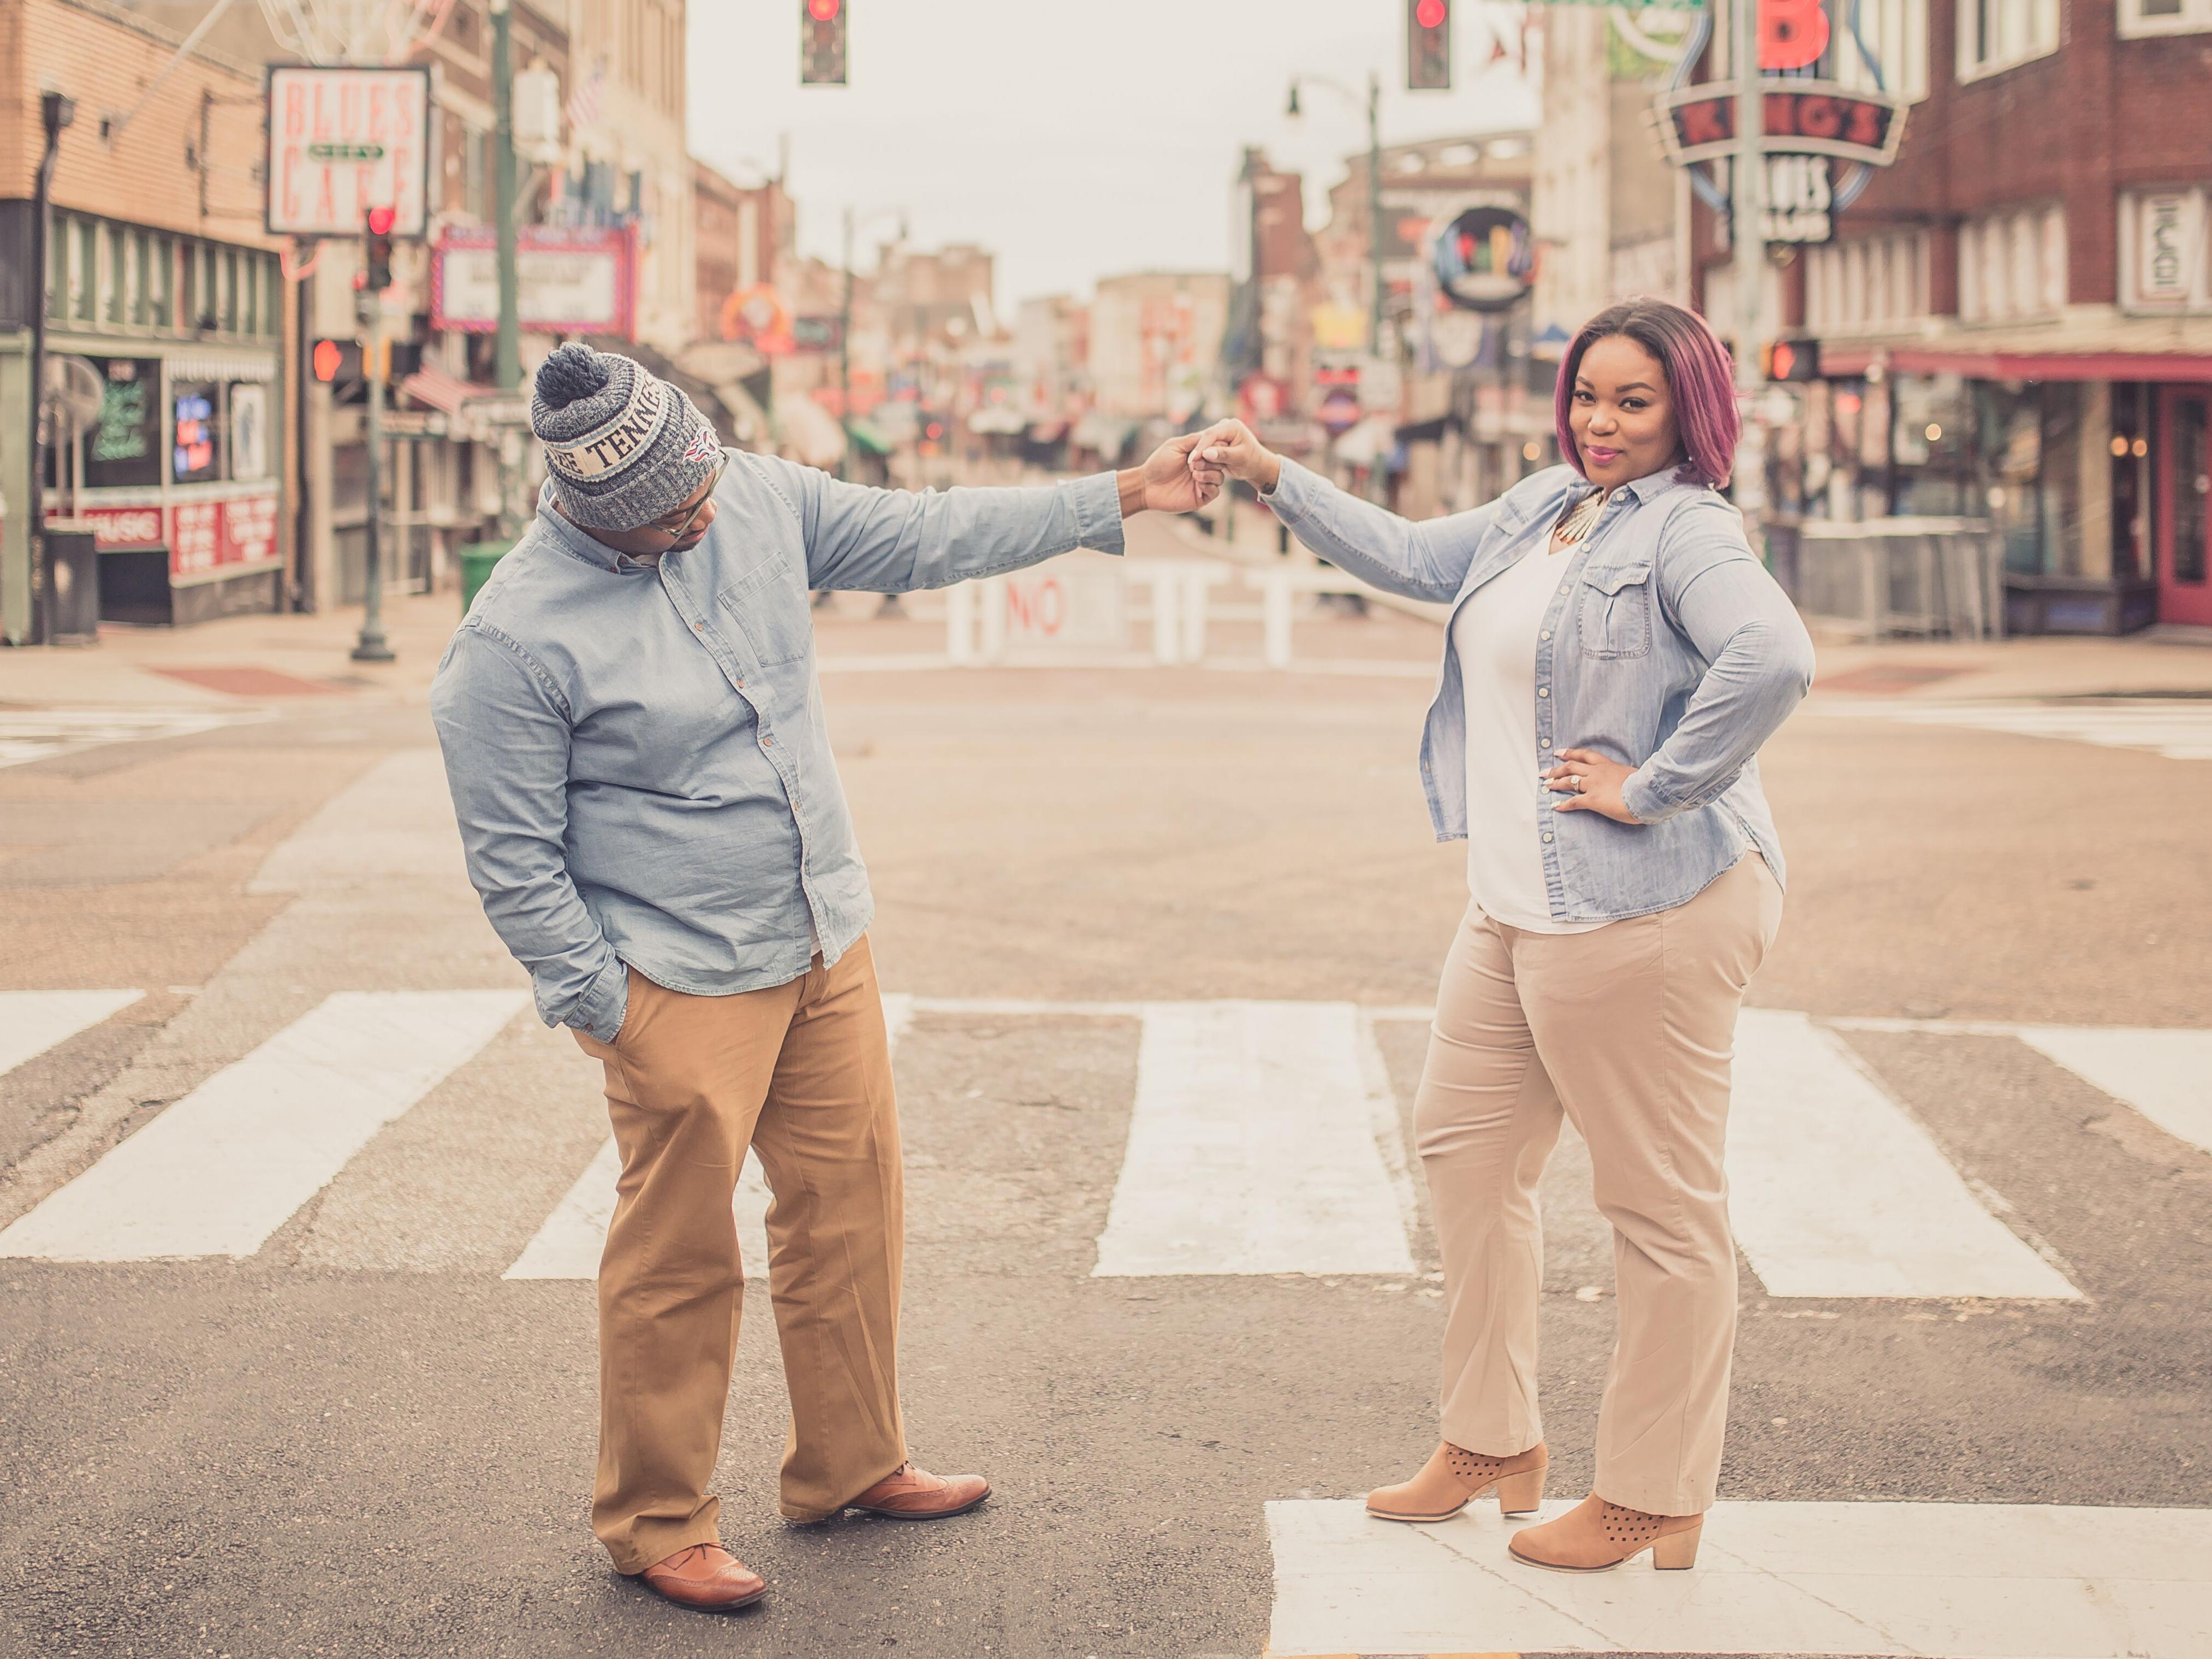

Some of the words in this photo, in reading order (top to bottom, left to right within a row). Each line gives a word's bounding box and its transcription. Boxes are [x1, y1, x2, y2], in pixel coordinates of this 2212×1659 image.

[285, 82, 413, 141] BLUES
[283, 146, 408, 223] CAFE
[1006, 577, 1065, 637] NO
